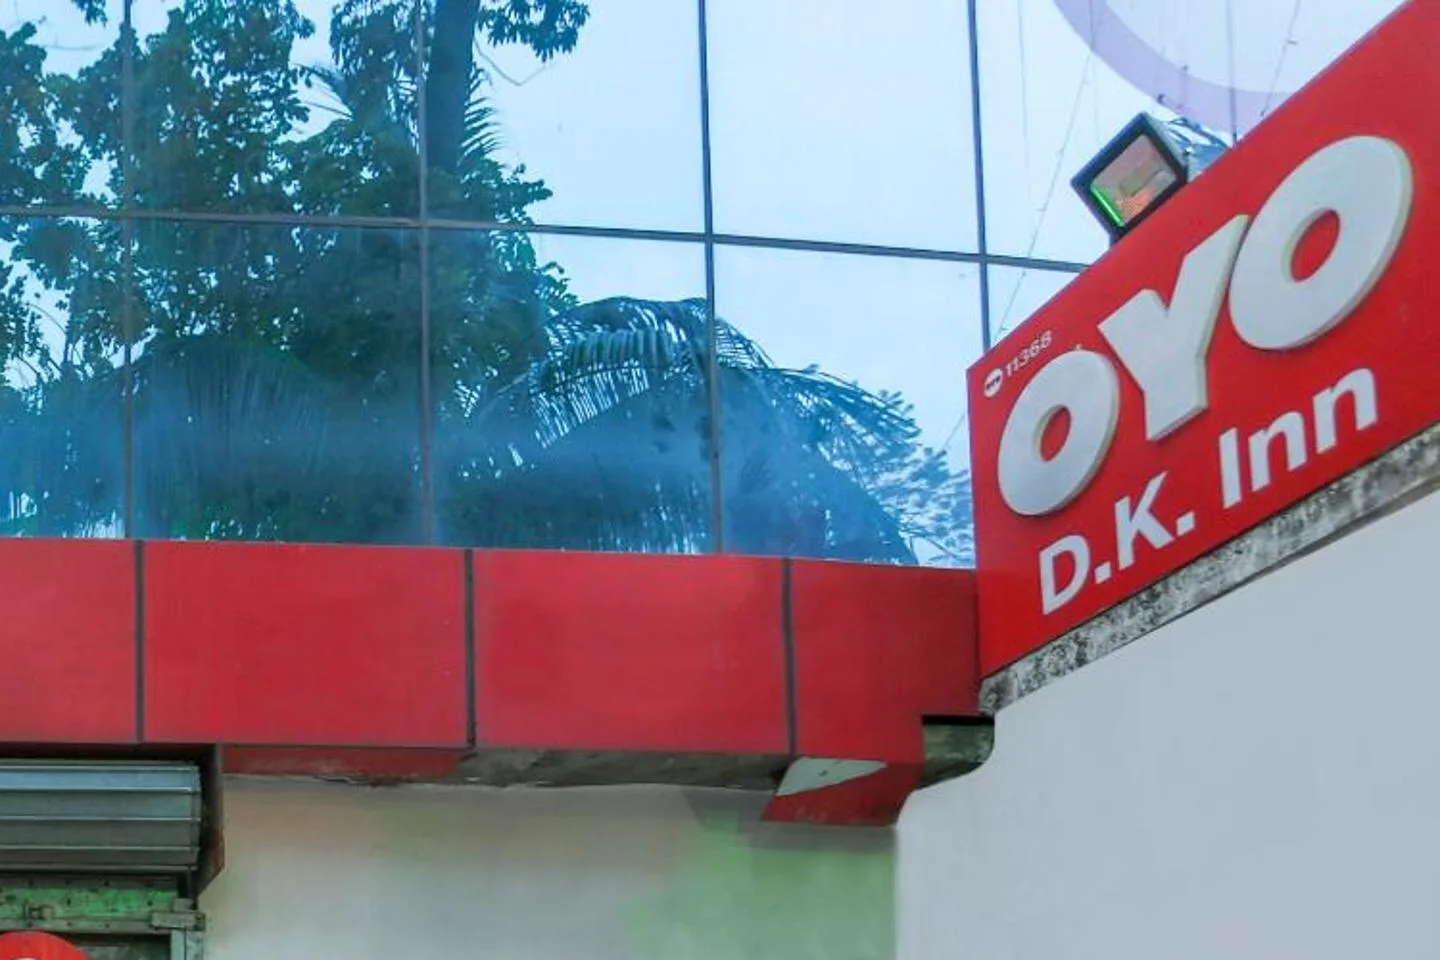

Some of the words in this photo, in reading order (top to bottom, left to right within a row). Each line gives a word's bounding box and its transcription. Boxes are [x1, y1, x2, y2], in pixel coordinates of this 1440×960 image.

[997, 135, 1414, 517] OYO
[1006, 330, 1053, 377] 11368
[1038, 471, 1197, 616] D.K.
[1218, 367, 1379, 510] Inn
